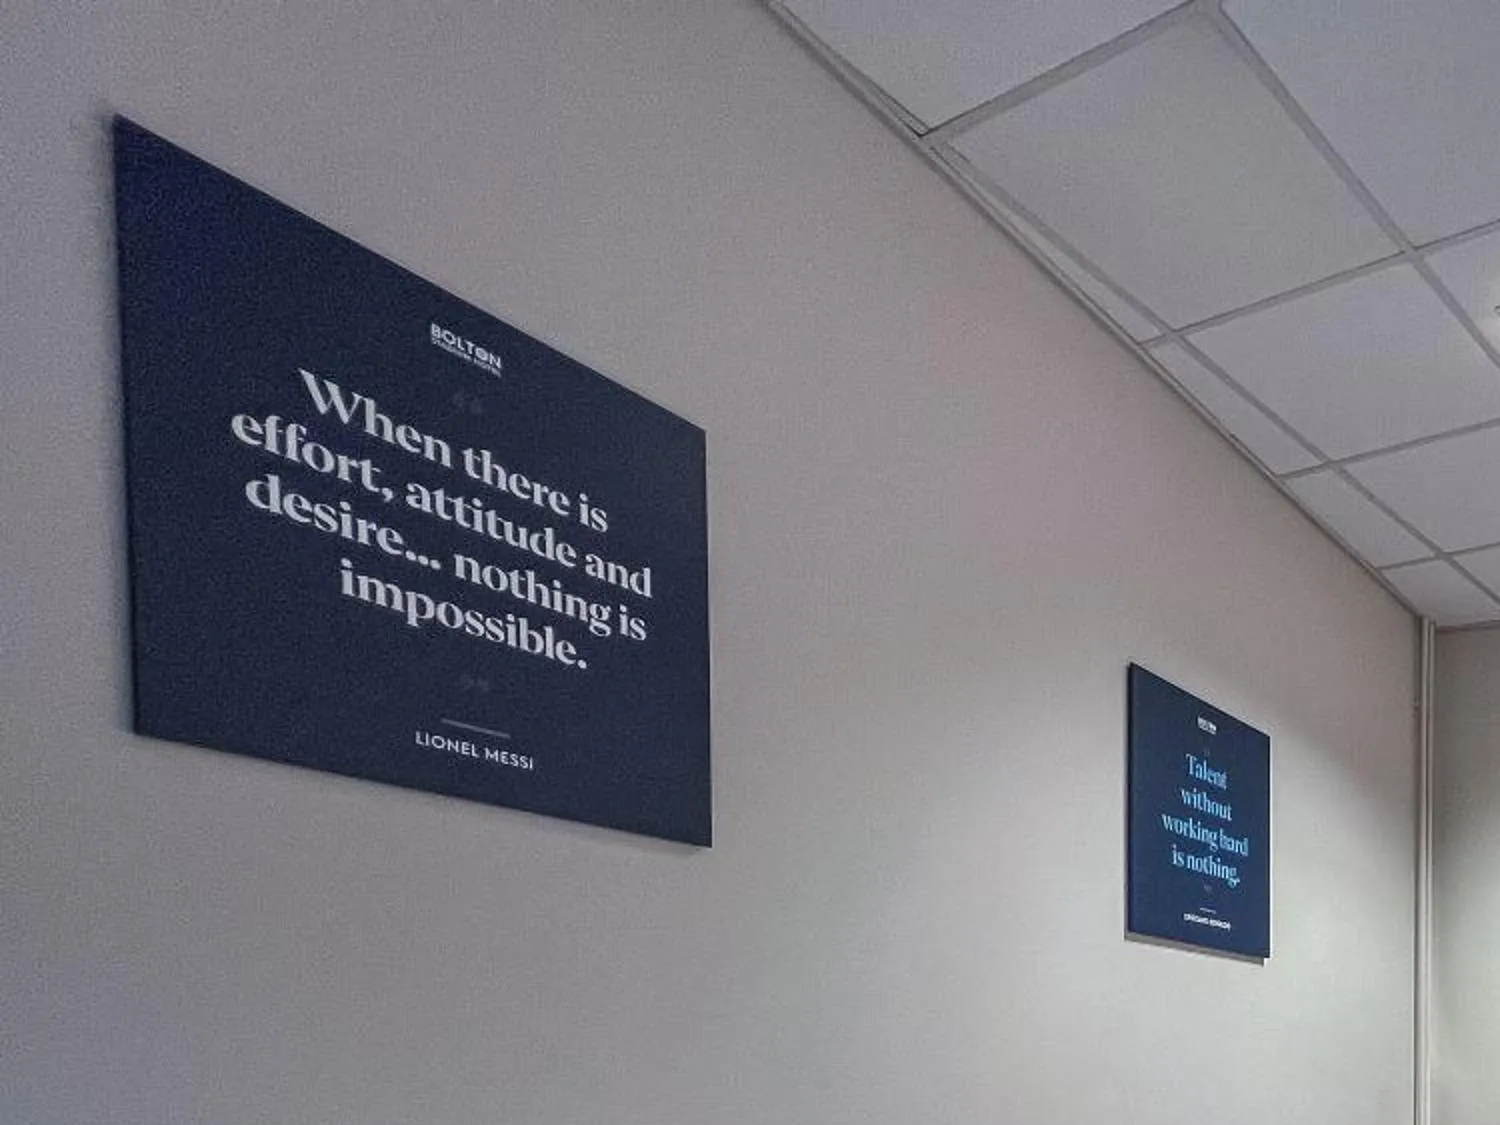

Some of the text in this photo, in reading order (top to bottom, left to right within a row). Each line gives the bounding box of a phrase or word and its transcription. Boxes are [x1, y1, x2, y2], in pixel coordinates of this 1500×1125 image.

[432, 322, 502, 369] BOLTON
[299, 368, 608, 533] When there is
[231, 414, 652, 598] effort, attitude and
[245, 473, 647, 641] desire... nothing is
[341, 557, 588, 669] impossible.
[415, 730, 534, 770] LIONEL MESSI
[1185, 752, 1227, 790] Talent
[1181, 787, 1232, 821] without
[1161, 813, 1248, 857] working hard
[1172, 843, 1240, 888] is nothing.
